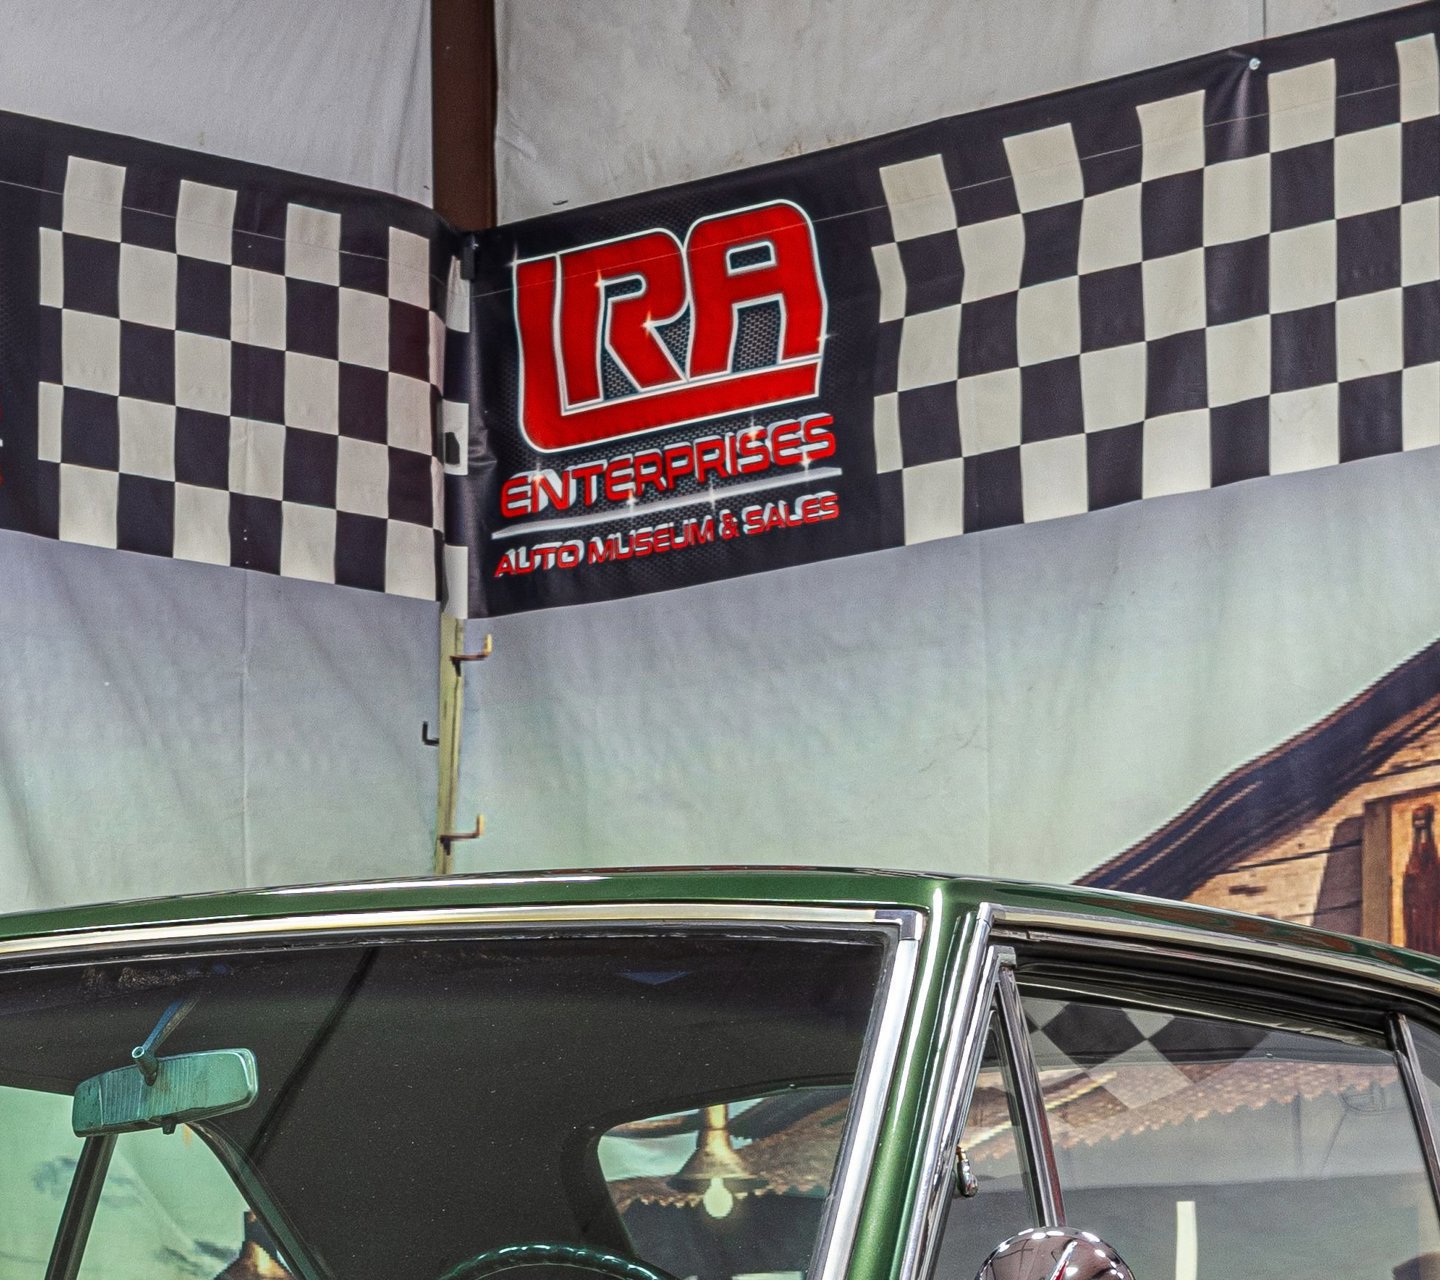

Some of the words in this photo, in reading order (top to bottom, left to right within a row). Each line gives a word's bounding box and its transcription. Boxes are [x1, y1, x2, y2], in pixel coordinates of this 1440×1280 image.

[500, 412, 837, 519] ENTERPRISES
[494, 535, 585, 578] AUTO
[588, 516, 715, 565] MUSEUM
[719, 508, 740, 540] &
[741, 489, 840, 532] SALES
